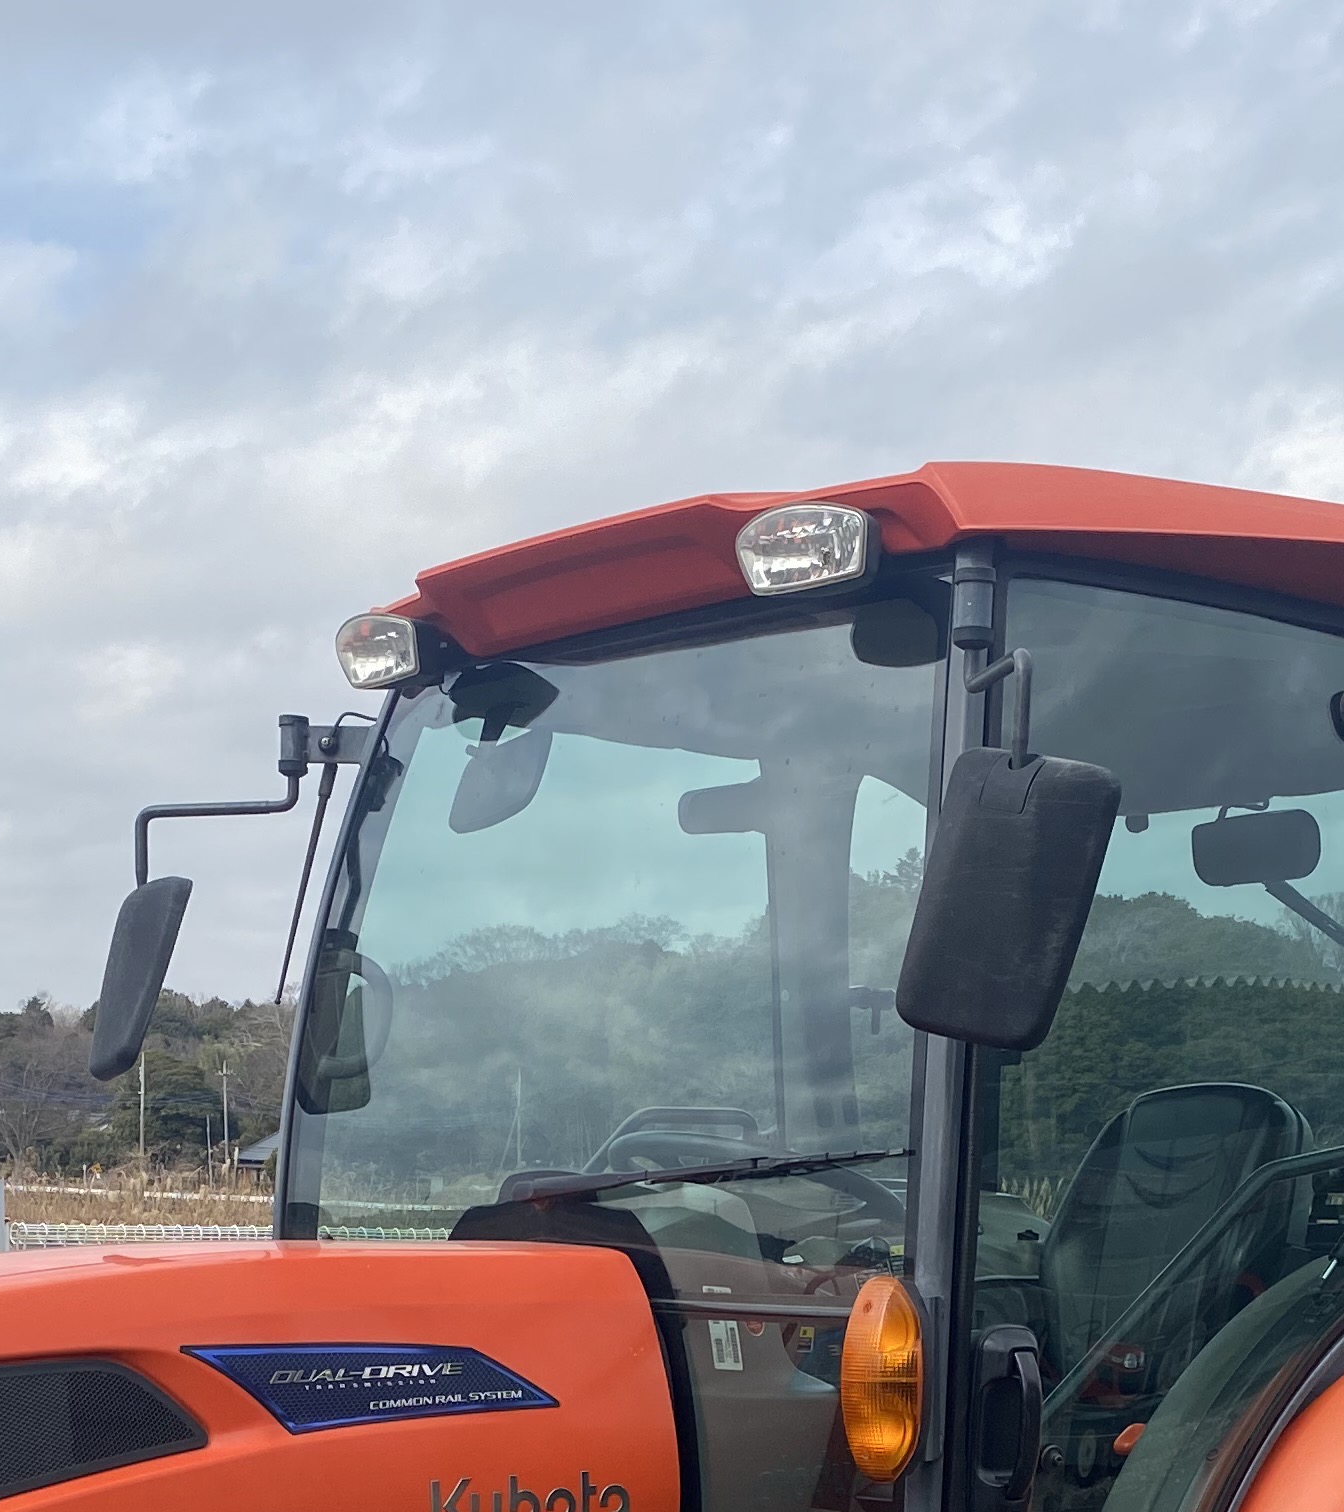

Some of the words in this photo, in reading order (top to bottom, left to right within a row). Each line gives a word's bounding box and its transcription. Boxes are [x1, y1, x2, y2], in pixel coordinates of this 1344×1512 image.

[269, 1362, 465, 1385] DUAL-DRIVE
[369, 1395, 433, 1411] COMMON
[435, 1392, 468, 1405] RAIL
[469, 1389, 523, 1402] SYSTEM
